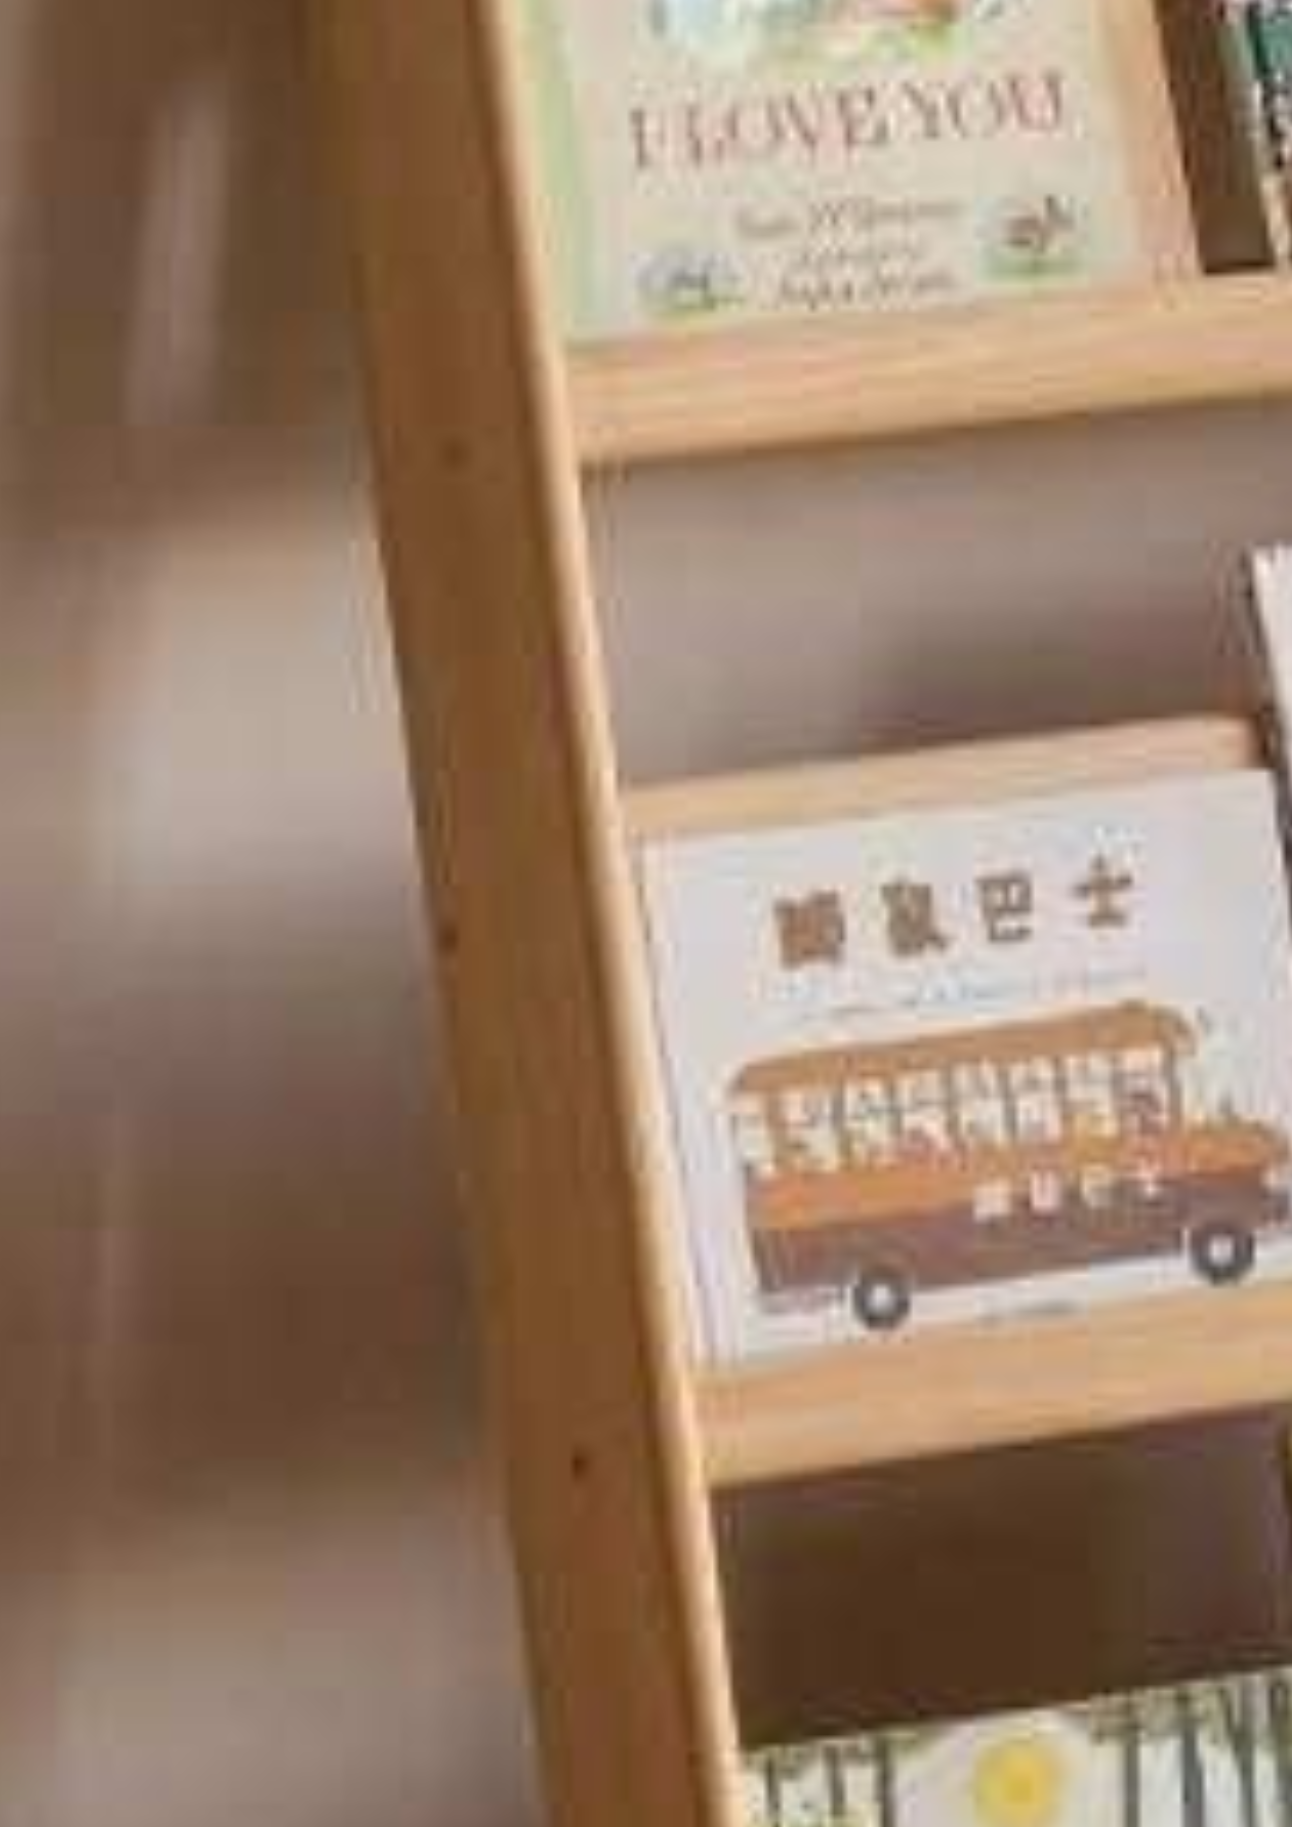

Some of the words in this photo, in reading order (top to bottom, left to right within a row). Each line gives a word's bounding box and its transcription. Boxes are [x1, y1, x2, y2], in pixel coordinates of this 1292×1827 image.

[630, 106, 652, 171] I
[682, 84, 892, 165] LOVE
[903, 70, 1067, 137] YOU
